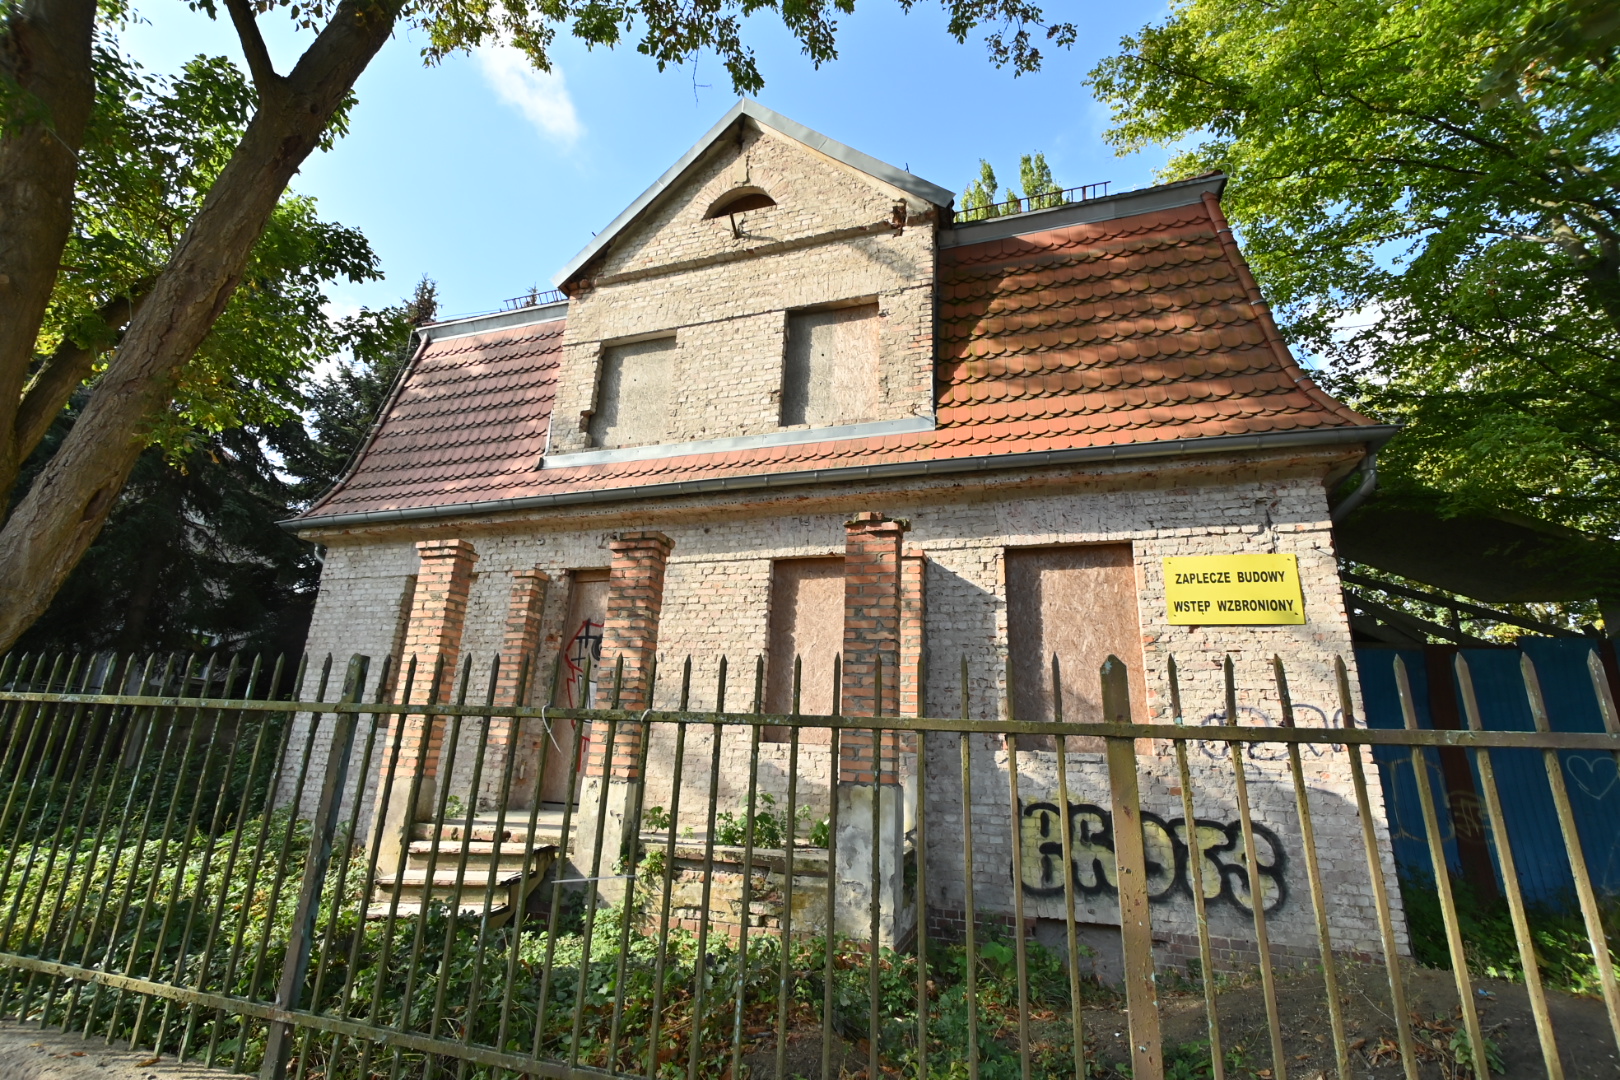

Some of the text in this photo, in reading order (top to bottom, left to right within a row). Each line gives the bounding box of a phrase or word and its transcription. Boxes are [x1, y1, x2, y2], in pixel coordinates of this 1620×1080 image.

[1175, 571, 1285, 584] ZAPLECZE BUDOWY
[1217, 599, 1294, 612] WZBRONIONY
